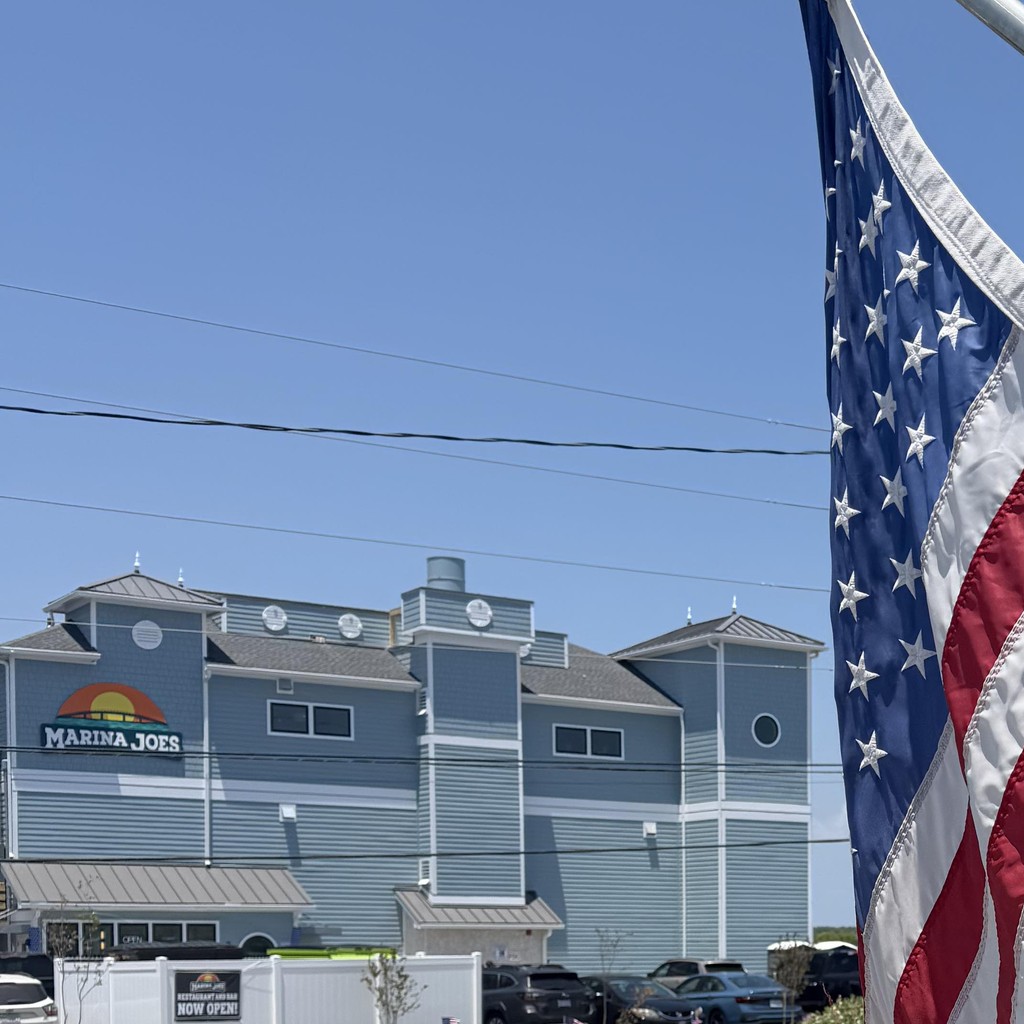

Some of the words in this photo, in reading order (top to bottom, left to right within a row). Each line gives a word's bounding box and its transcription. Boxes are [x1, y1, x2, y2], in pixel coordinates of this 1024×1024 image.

[45, 727, 128, 748] MARINA
[131, 733, 180, 752] JOES
[122, 935, 143, 944] OPEN
[177, 992, 215, 1001] RESTAURANT
[215, 993, 226, 1001] AND
[177, 1002, 205, 1016] NOW
[206, 1002, 238, 1015] OPEN!
